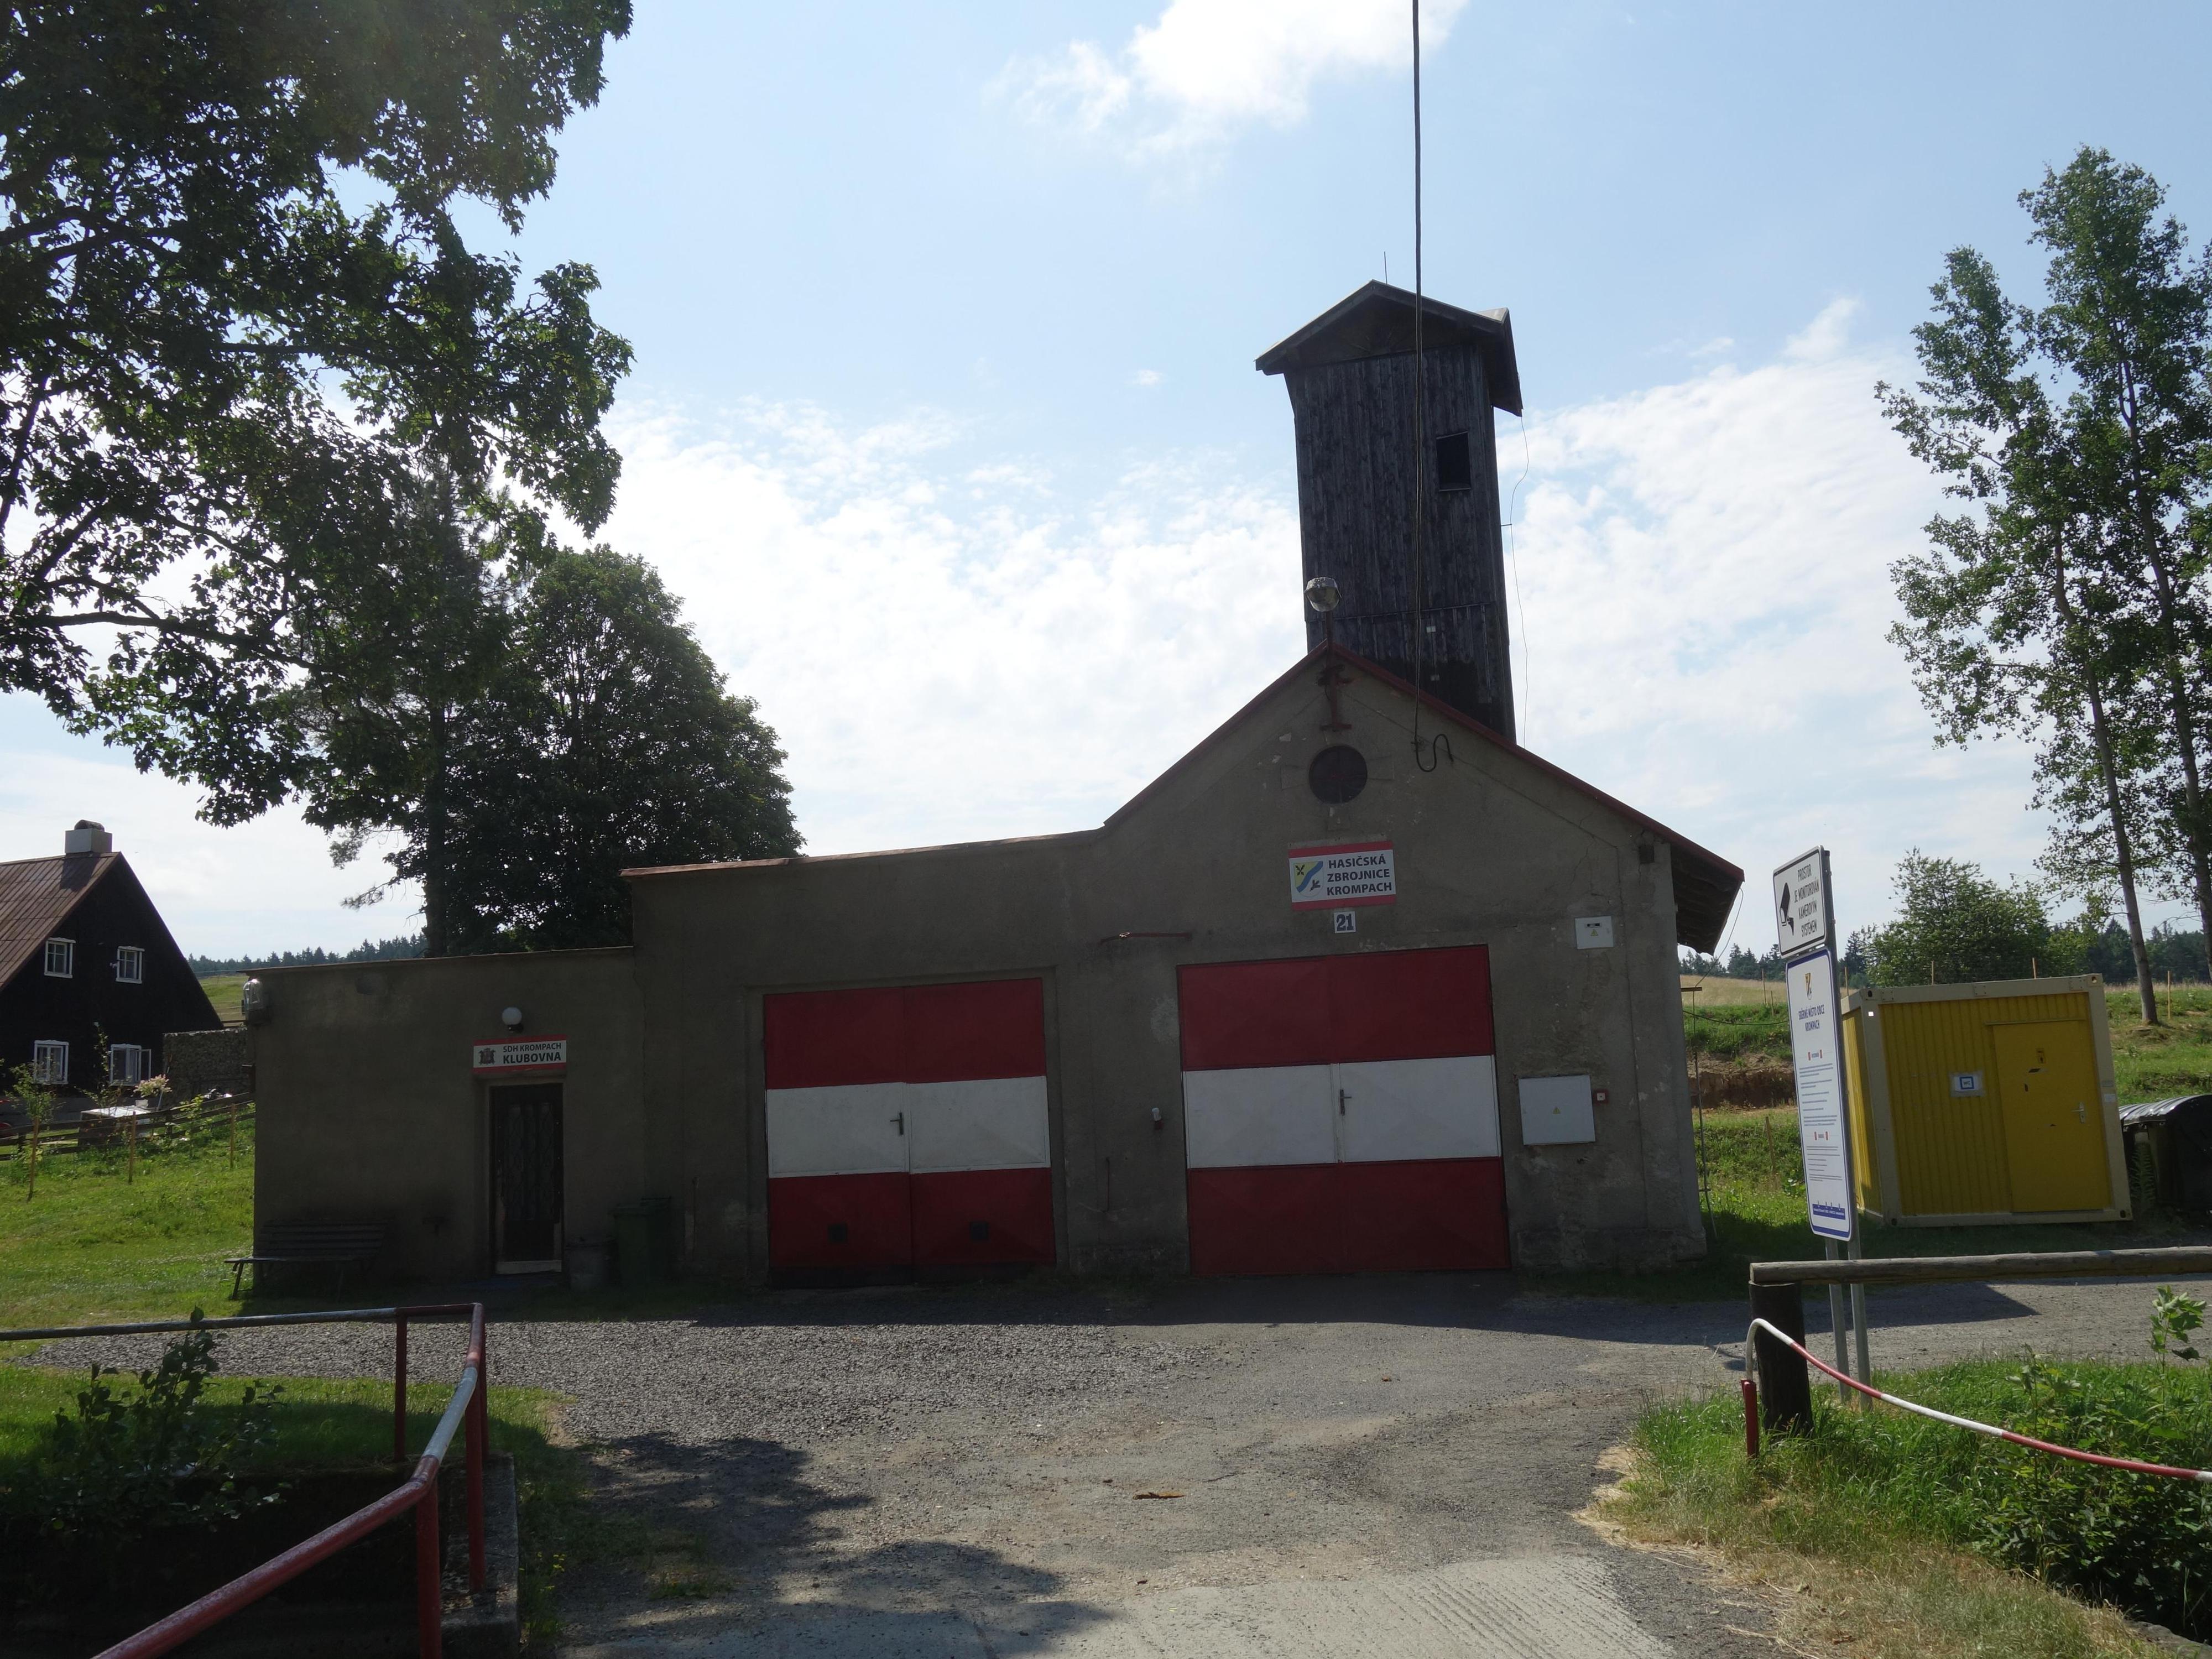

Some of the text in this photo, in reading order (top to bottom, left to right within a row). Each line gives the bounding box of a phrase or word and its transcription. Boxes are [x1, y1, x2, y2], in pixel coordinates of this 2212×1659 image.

[1328, 854, 1386, 869] HASIČSKÁ
[1327, 869, 1390, 883] ZBROJNICE
[1797, 864, 1812, 882] PROSTOR
[1327, 882, 1392, 896] KROMPACH
[1794, 877, 1819, 903] JE MONITOROVÁN
[1798, 898, 1818, 920] KAMEROVÝM
[1336, 914, 1354, 931] 21
[1801, 919, 1817, 937] SYSTÉMEM
[1817, 1004, 1825, 1015] OBCE
[1805, 1020, 1820, 1031] KROMPACH
[520, 1043, 561, 1051] KROMPACH
[503, 1052, 561, 1064] KLUBOVNA
